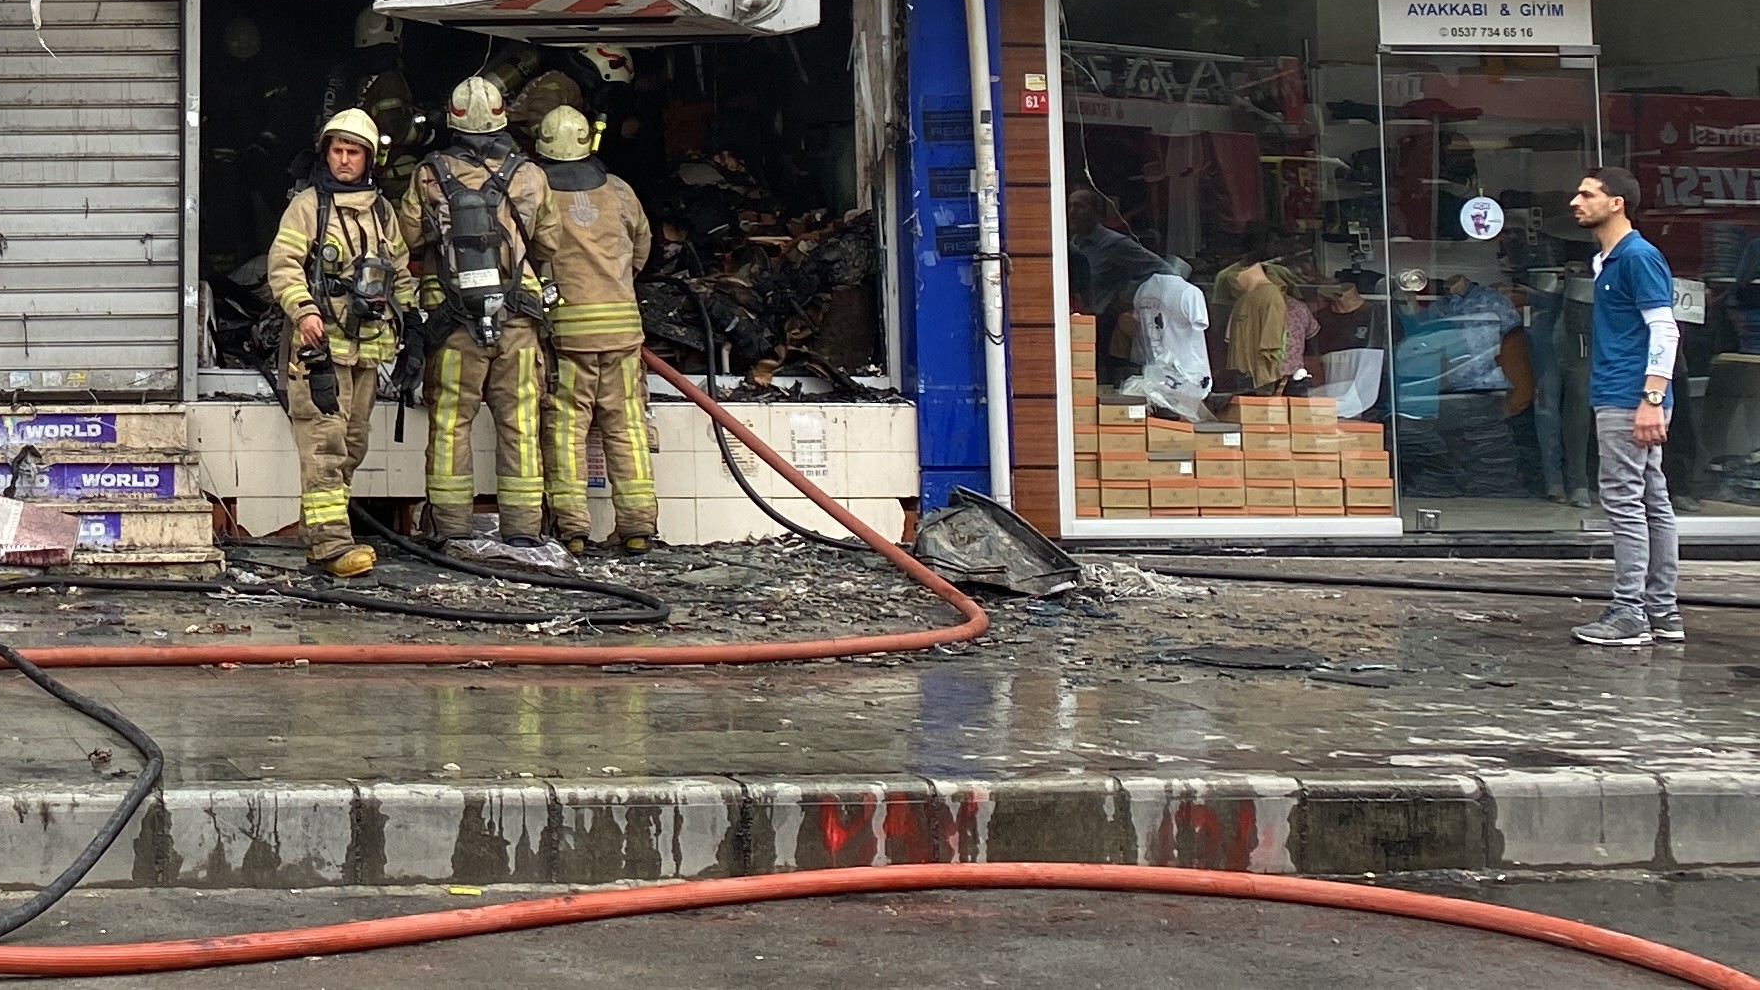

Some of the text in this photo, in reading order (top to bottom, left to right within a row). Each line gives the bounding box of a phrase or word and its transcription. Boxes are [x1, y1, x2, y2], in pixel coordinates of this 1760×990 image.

[1408, 0, 1564, 17] AYAKKABI & GİYİM
[1451, 26, 1477, 37] 0537
[1481, 26, 1500, 37] 734
[1503, 26, 1516, 37] 65
[1025, 95, 1039, 109] 61
[25, 423, 102, 438] WORLD
[81, 472, 160, 488] WORLD
